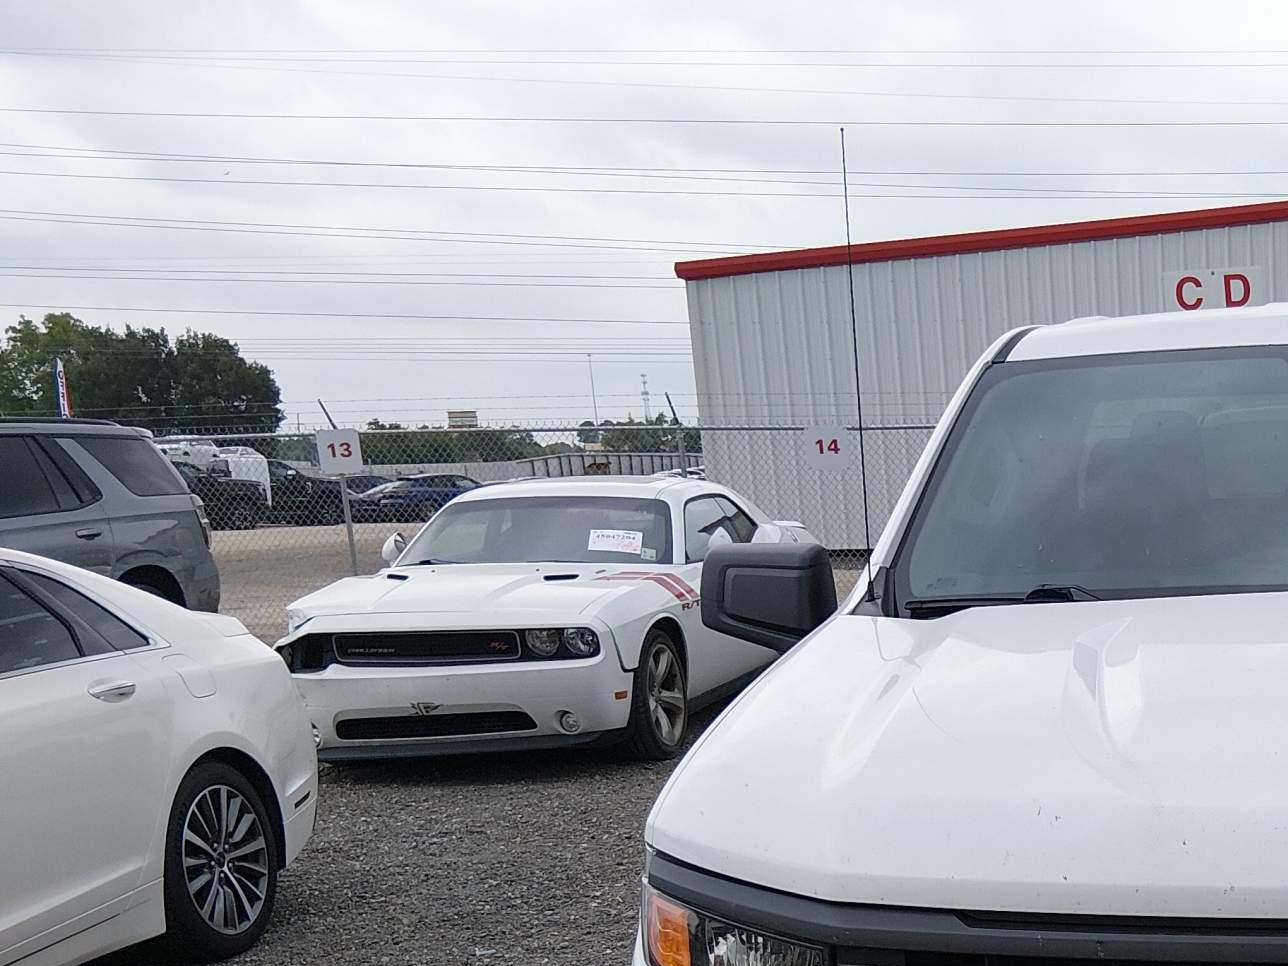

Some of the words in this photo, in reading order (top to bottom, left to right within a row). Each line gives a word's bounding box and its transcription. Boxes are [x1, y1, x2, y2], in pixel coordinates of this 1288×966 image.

[1175, 276, 1204, 311] C
[1223, 273, 1251, 308] D
[327, 442, 352, 458] 13
[815, 439, 841, 455] 14
